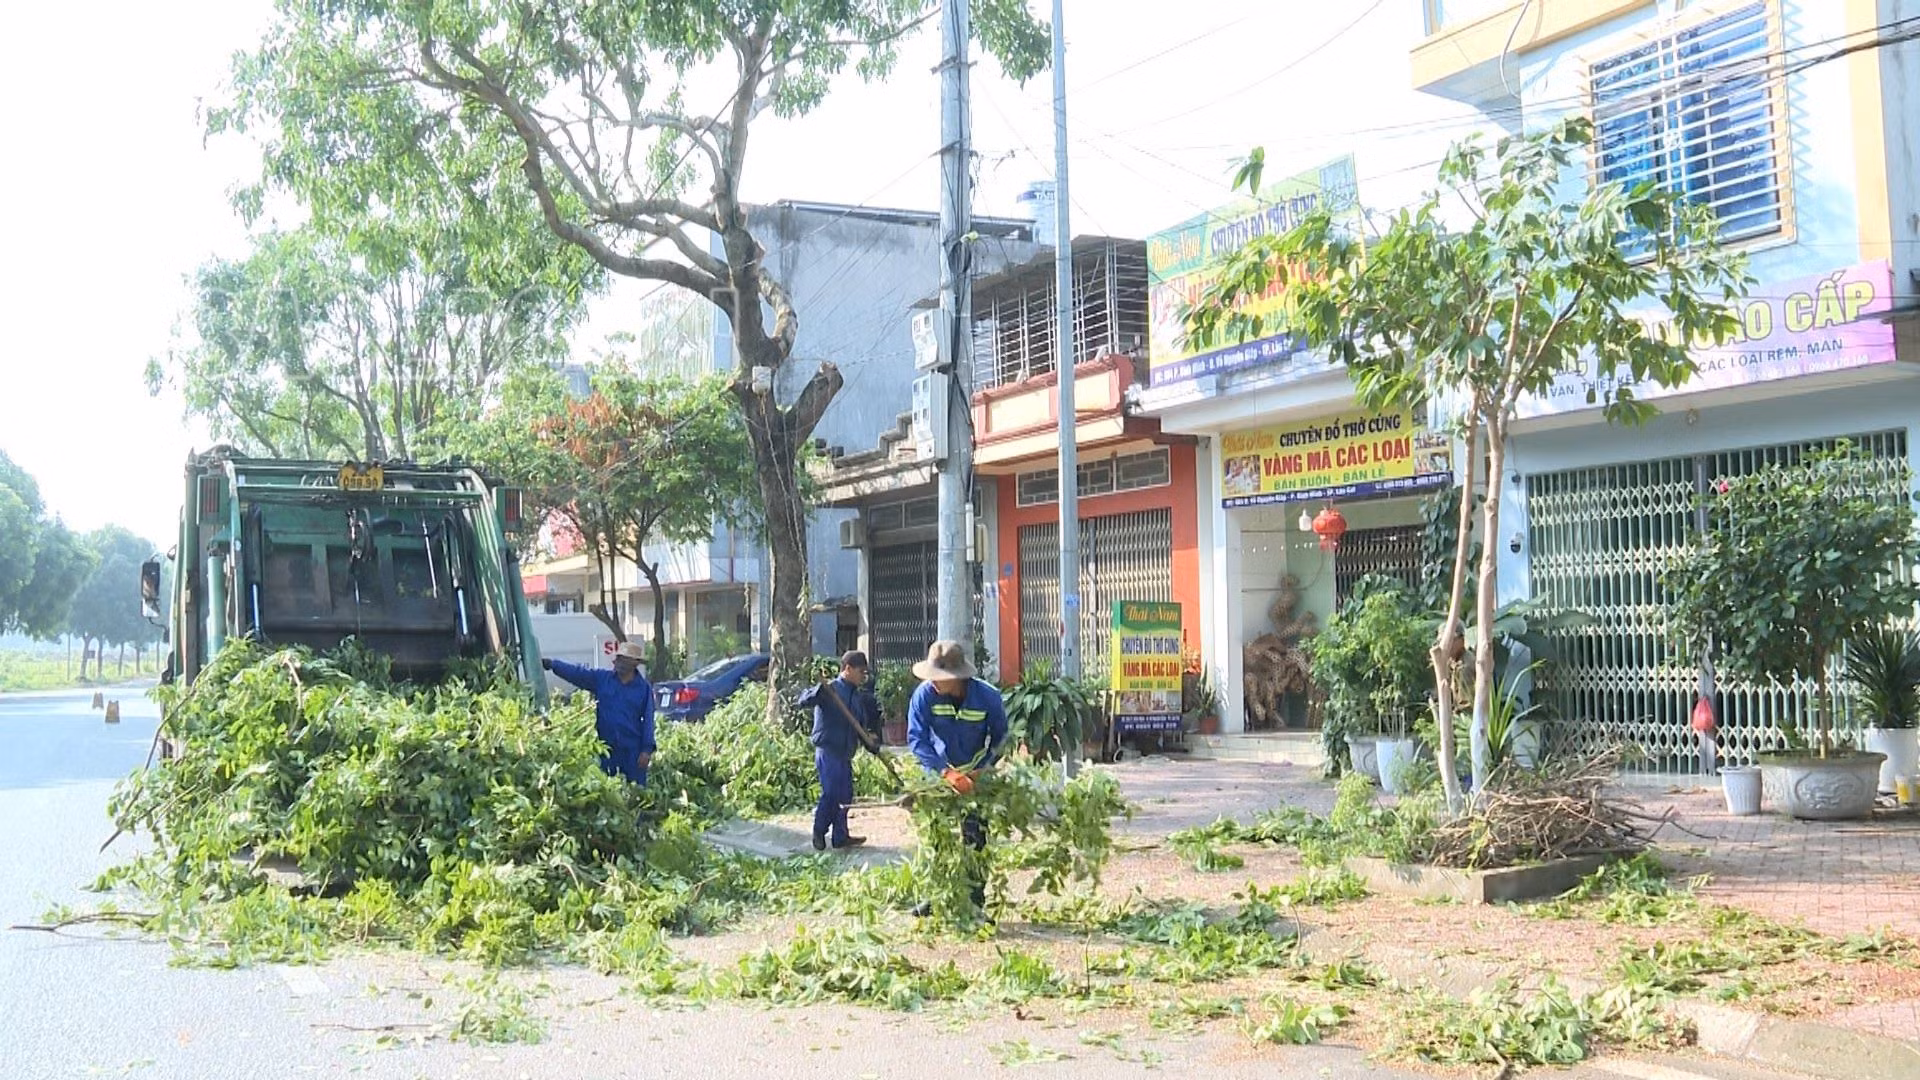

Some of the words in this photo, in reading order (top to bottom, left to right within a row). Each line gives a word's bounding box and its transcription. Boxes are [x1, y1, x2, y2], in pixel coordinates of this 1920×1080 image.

[1784, 271, 1874, 332] CẤP
[1343, 417, 1365, 437] THỜ
[1368, 413, 1401, 434] CÚNG
[1263, 452, 1303, 477] VÀNG
[1307, 446, 1333, 472] MÃ
[1336, 442, 1368, 467] CÁC
[1372, 436, 1411, 463] LOẠI
